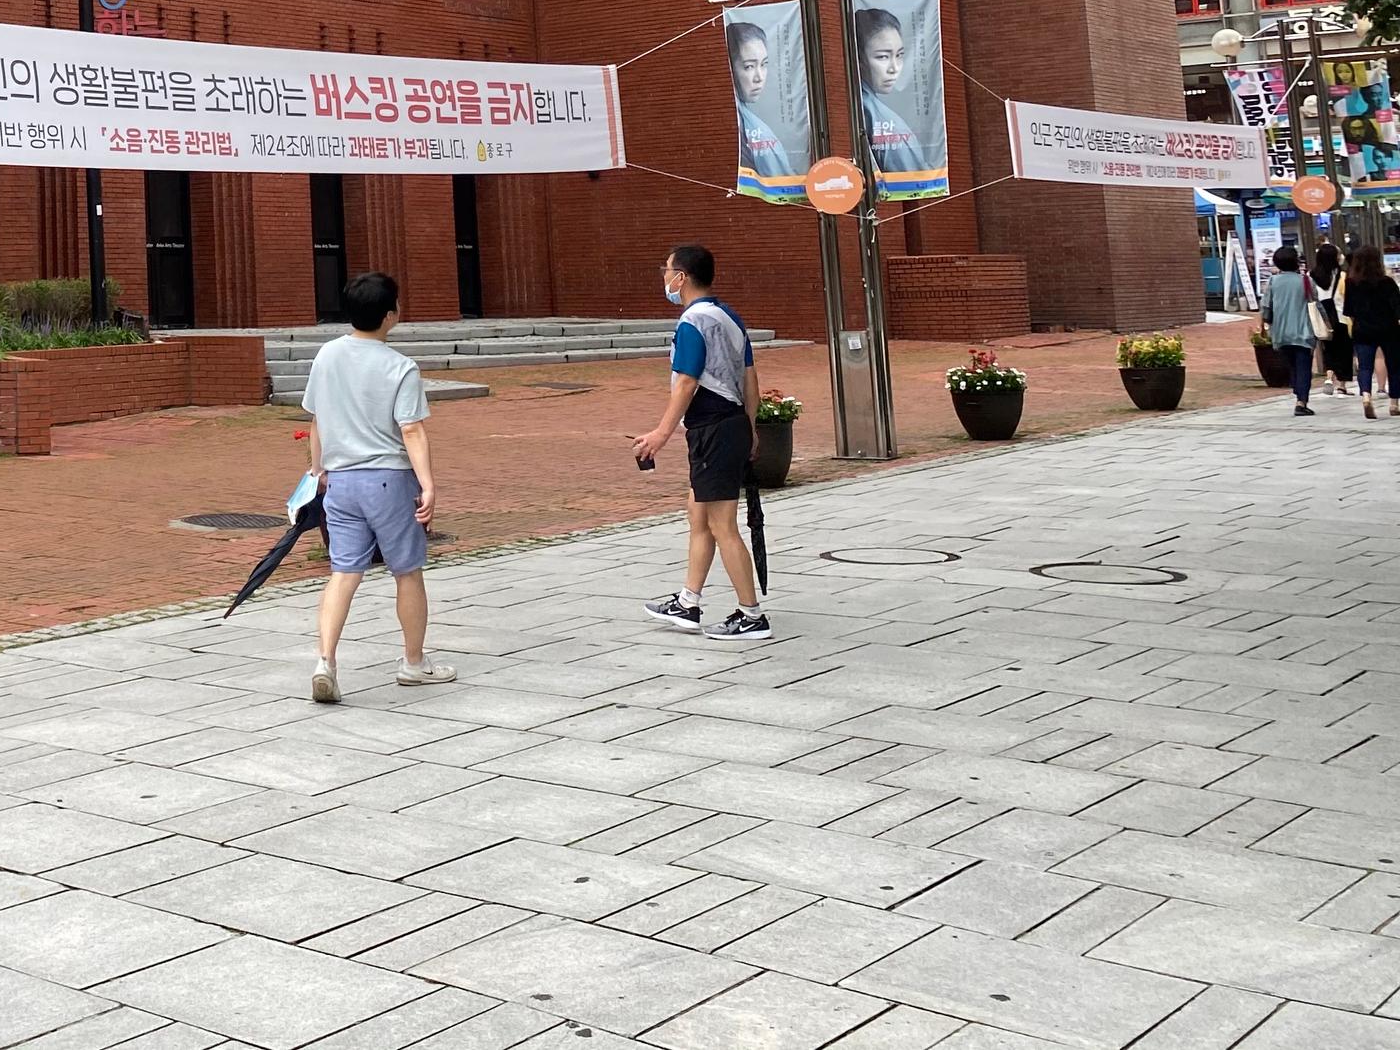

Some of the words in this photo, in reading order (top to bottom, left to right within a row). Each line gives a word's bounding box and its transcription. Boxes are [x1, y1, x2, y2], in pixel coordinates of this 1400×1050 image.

[49, 62, 197, 112] 생활불편을
[203, 73, 307, 118] 초래하는
[310, 73, 399, 123] 버스킹
[403, 78, 482, 125] 공연을
[487, 81, 592, 126] 금지합니다.
[27, 123, 64, 150] 행위
[71, 125, 87, 150] 시
[250, 134, 315, 158] 제24조에
[318, 136, 346, 158] 따라
[348, 136, 401, 159] 과태료가
[404, 138, 469, 161] 부과됩니다.
[487, 142, 513, 158] 종로구
[1030, 122, 1052, 146] 인근
[1054, 125, 1085, 149] 주민의
[1085, 128, 1132, 154] 생활불편을
